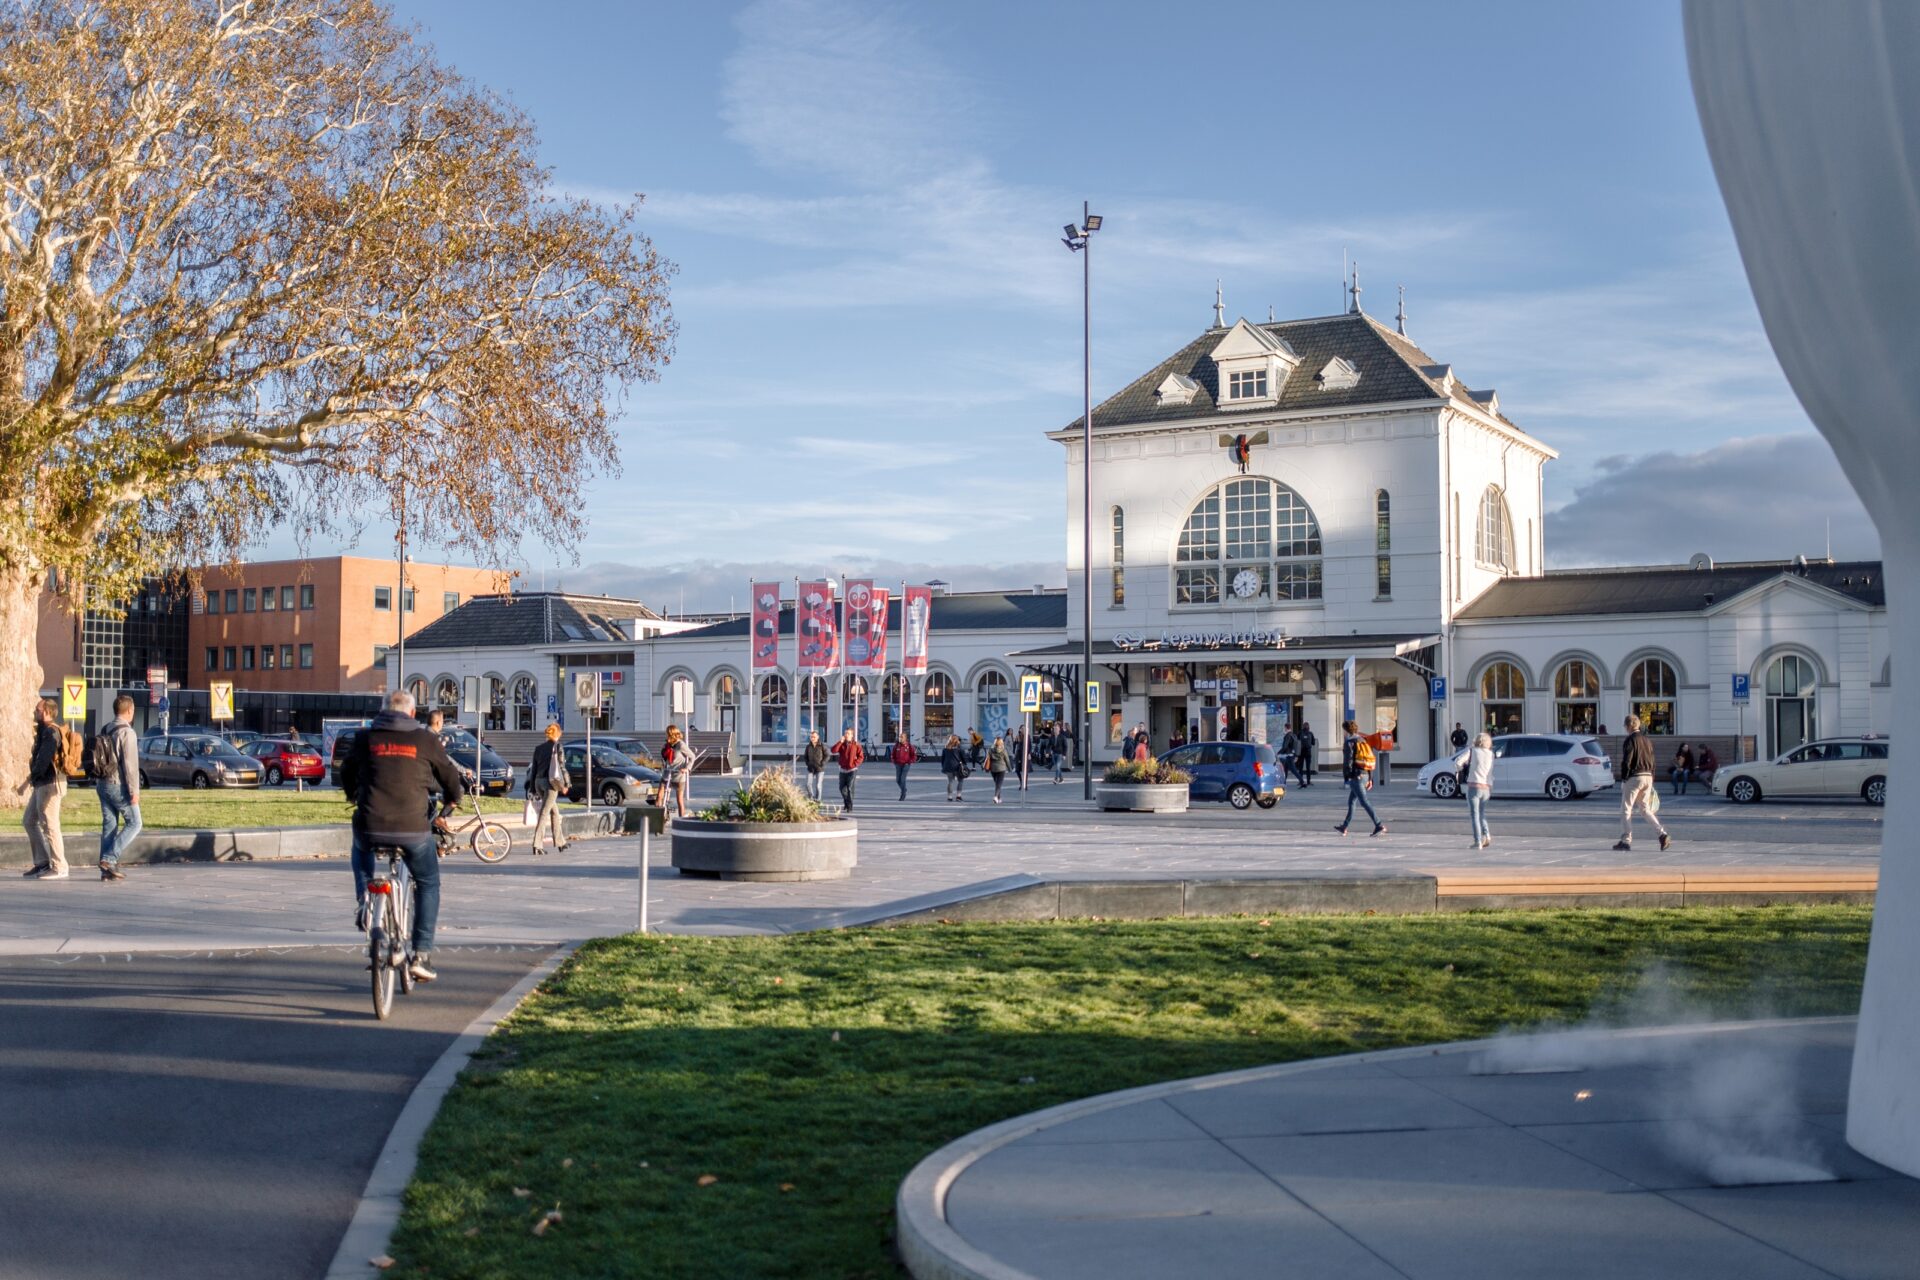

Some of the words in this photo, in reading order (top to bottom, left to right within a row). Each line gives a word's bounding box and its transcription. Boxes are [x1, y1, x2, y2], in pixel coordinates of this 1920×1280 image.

[1160, 626, 1281, 645] Leeuwarden
[1434, 680, 1443, 692] P
[1736, 676, 1745, 689] P
